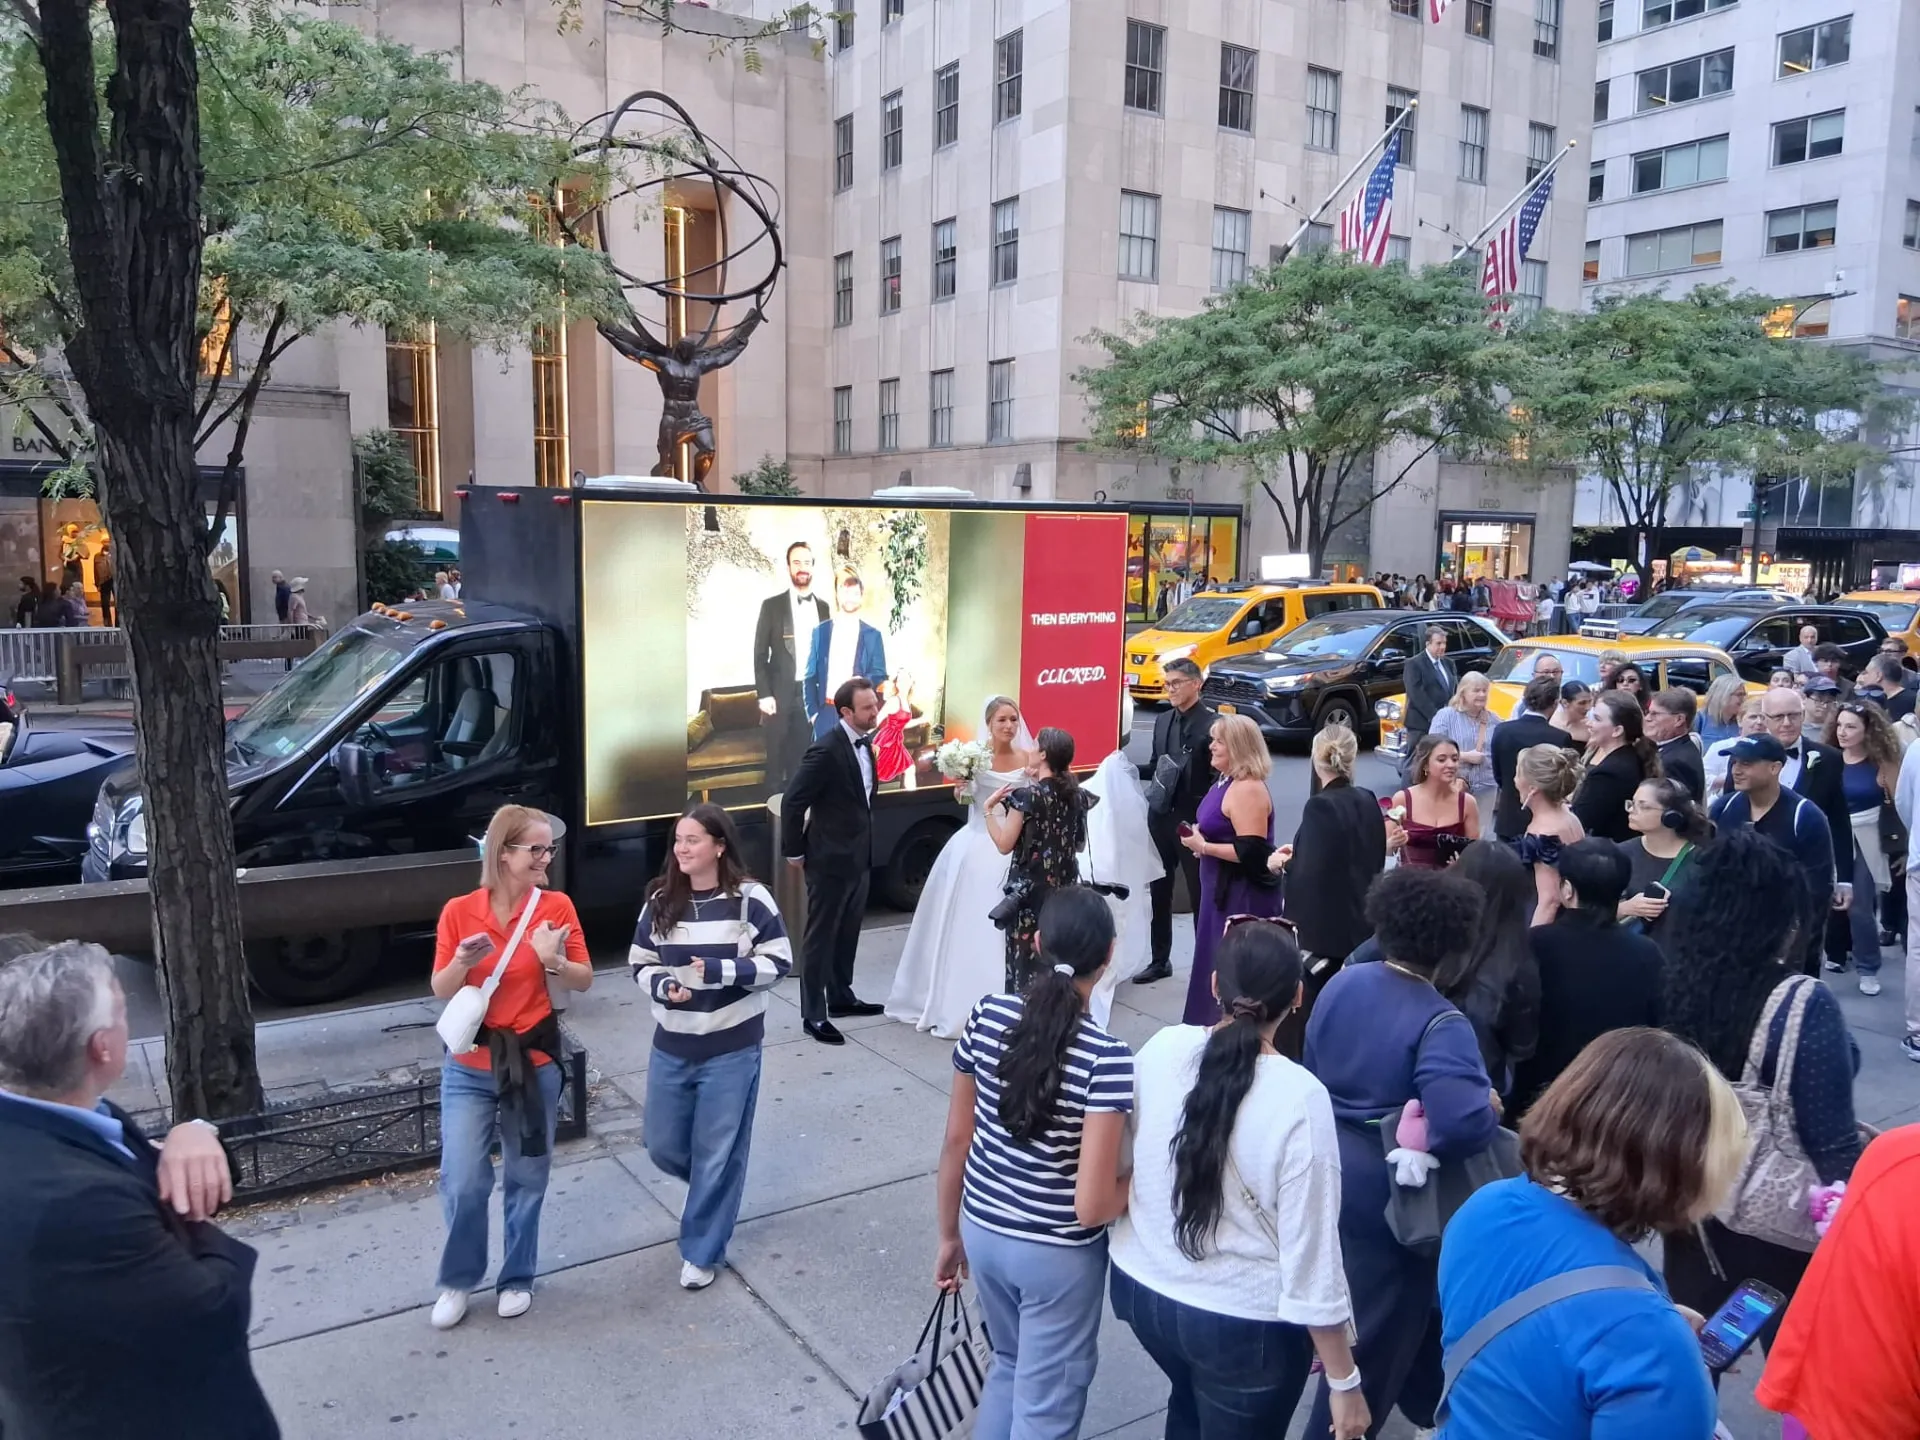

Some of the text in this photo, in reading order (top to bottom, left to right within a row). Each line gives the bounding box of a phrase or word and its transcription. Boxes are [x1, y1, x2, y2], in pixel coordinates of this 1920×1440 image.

[1031, 611, 1116, 625] THEN EVERYTHING
[1037, 666, 1107, 686] CLICKED.
